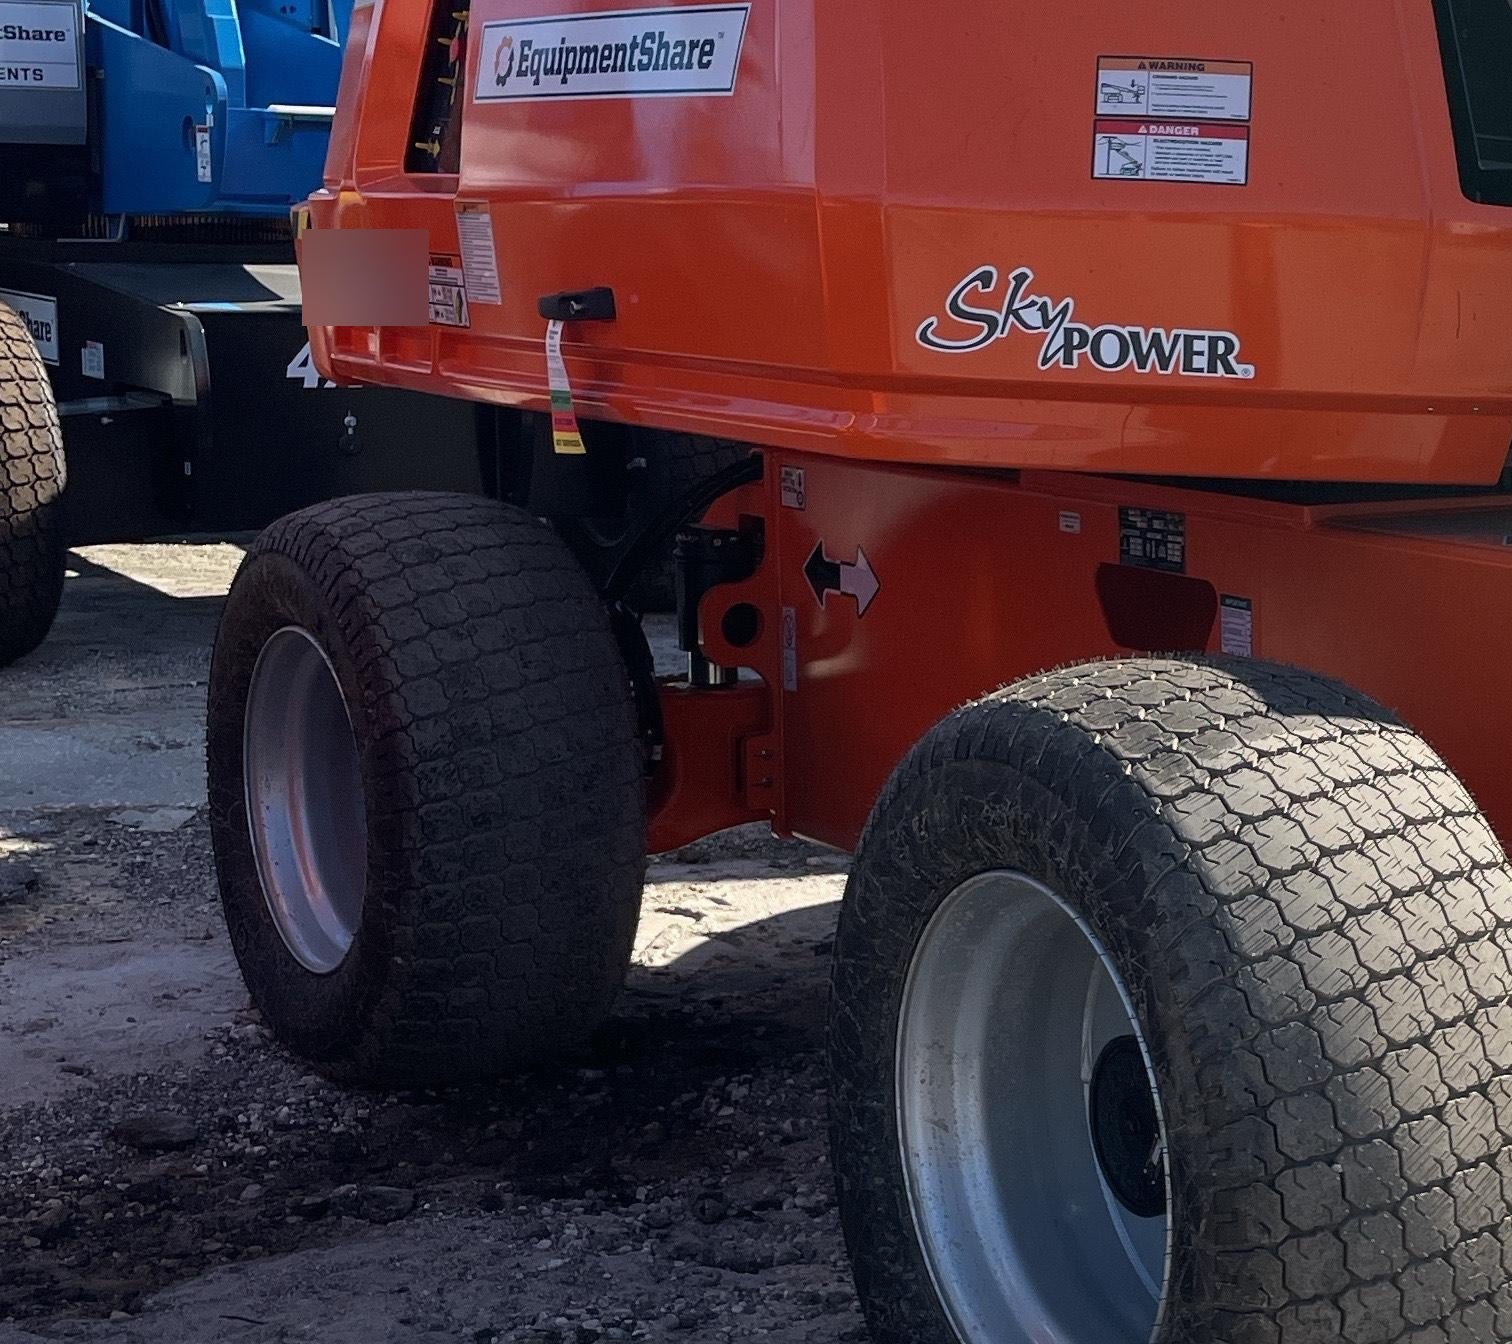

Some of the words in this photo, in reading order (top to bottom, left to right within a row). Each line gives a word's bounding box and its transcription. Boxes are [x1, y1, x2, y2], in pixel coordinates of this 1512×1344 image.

[516, 30, 715, 86] EquipmentShare
[1149, 60, 1205, 72] WARNING
[1149, 124, 1200, 136] DANGER
